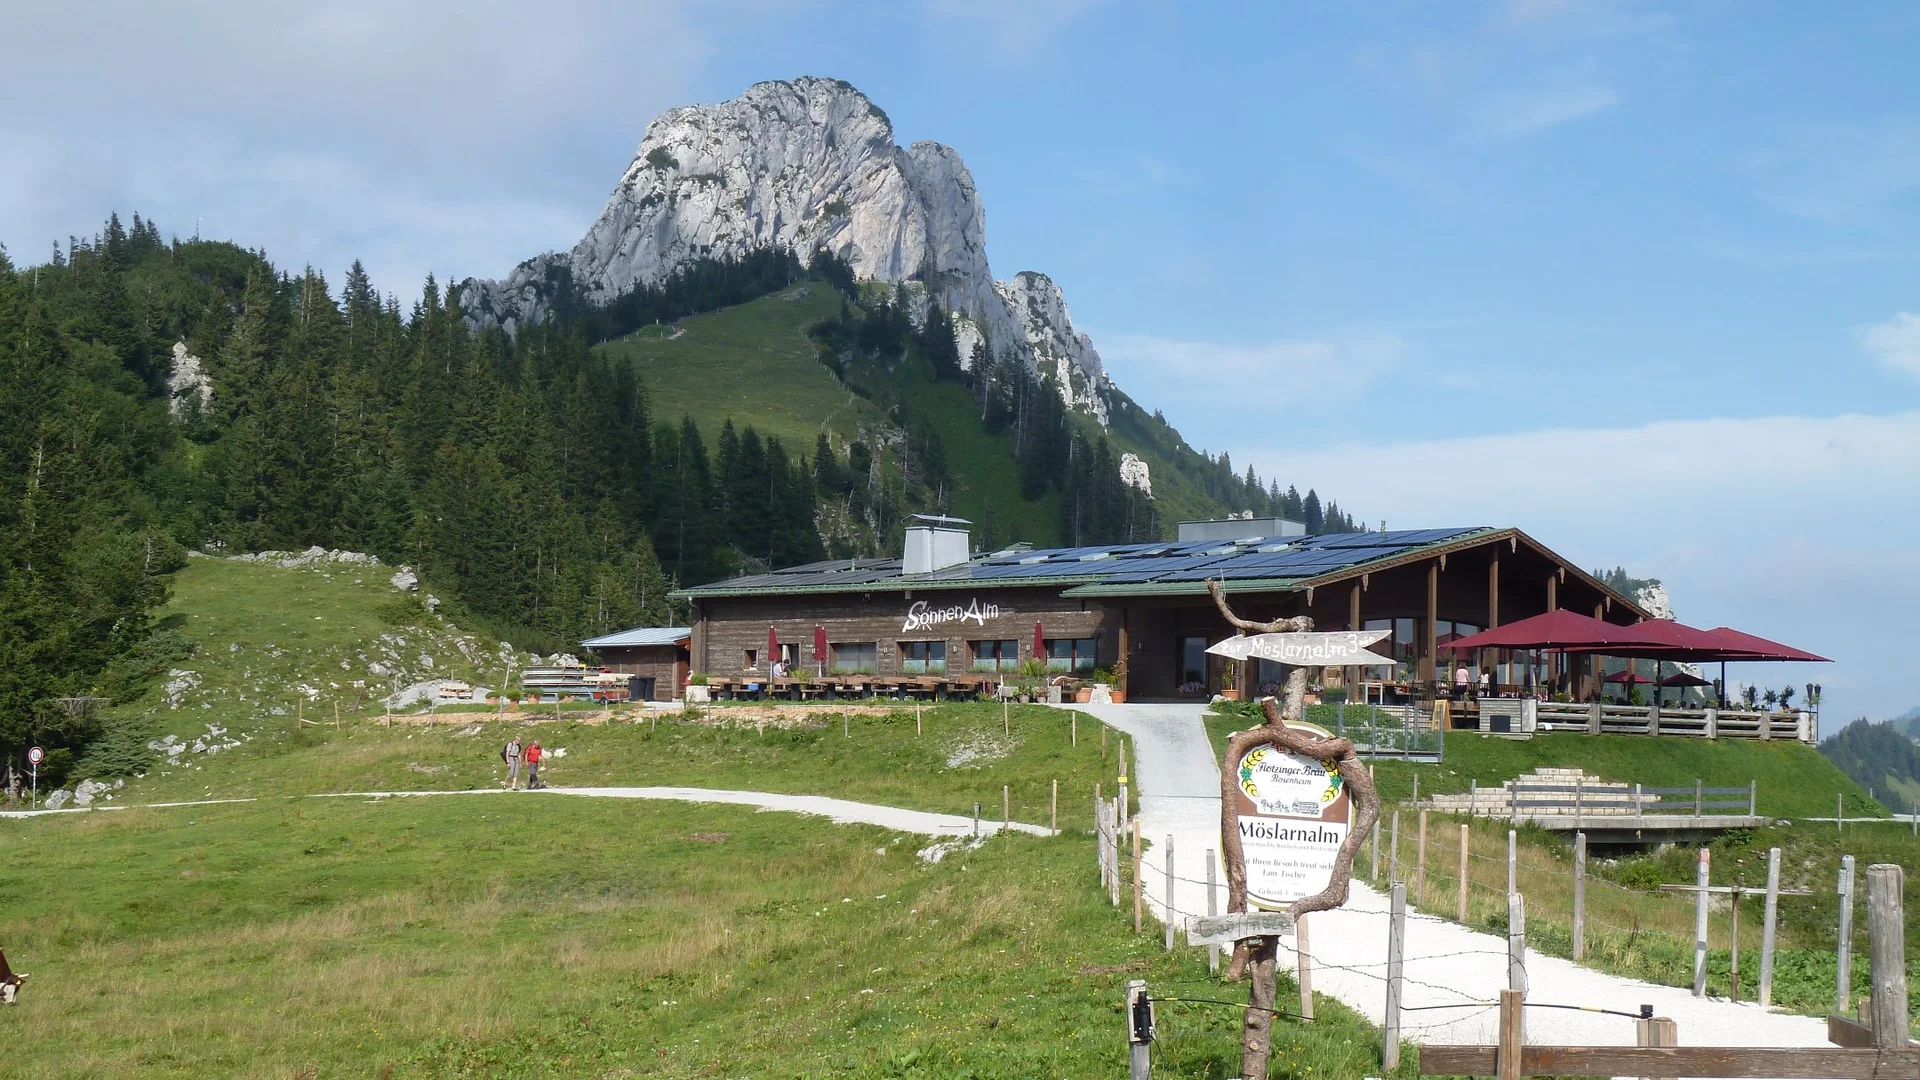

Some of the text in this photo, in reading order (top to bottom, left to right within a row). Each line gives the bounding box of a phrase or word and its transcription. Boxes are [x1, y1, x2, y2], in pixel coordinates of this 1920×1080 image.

[1249, 637, 1347, 659] Möslarnalm
[1347, 633, 1358, 653] 3
[1240, 821, 1339, 843] Möslarnalm
